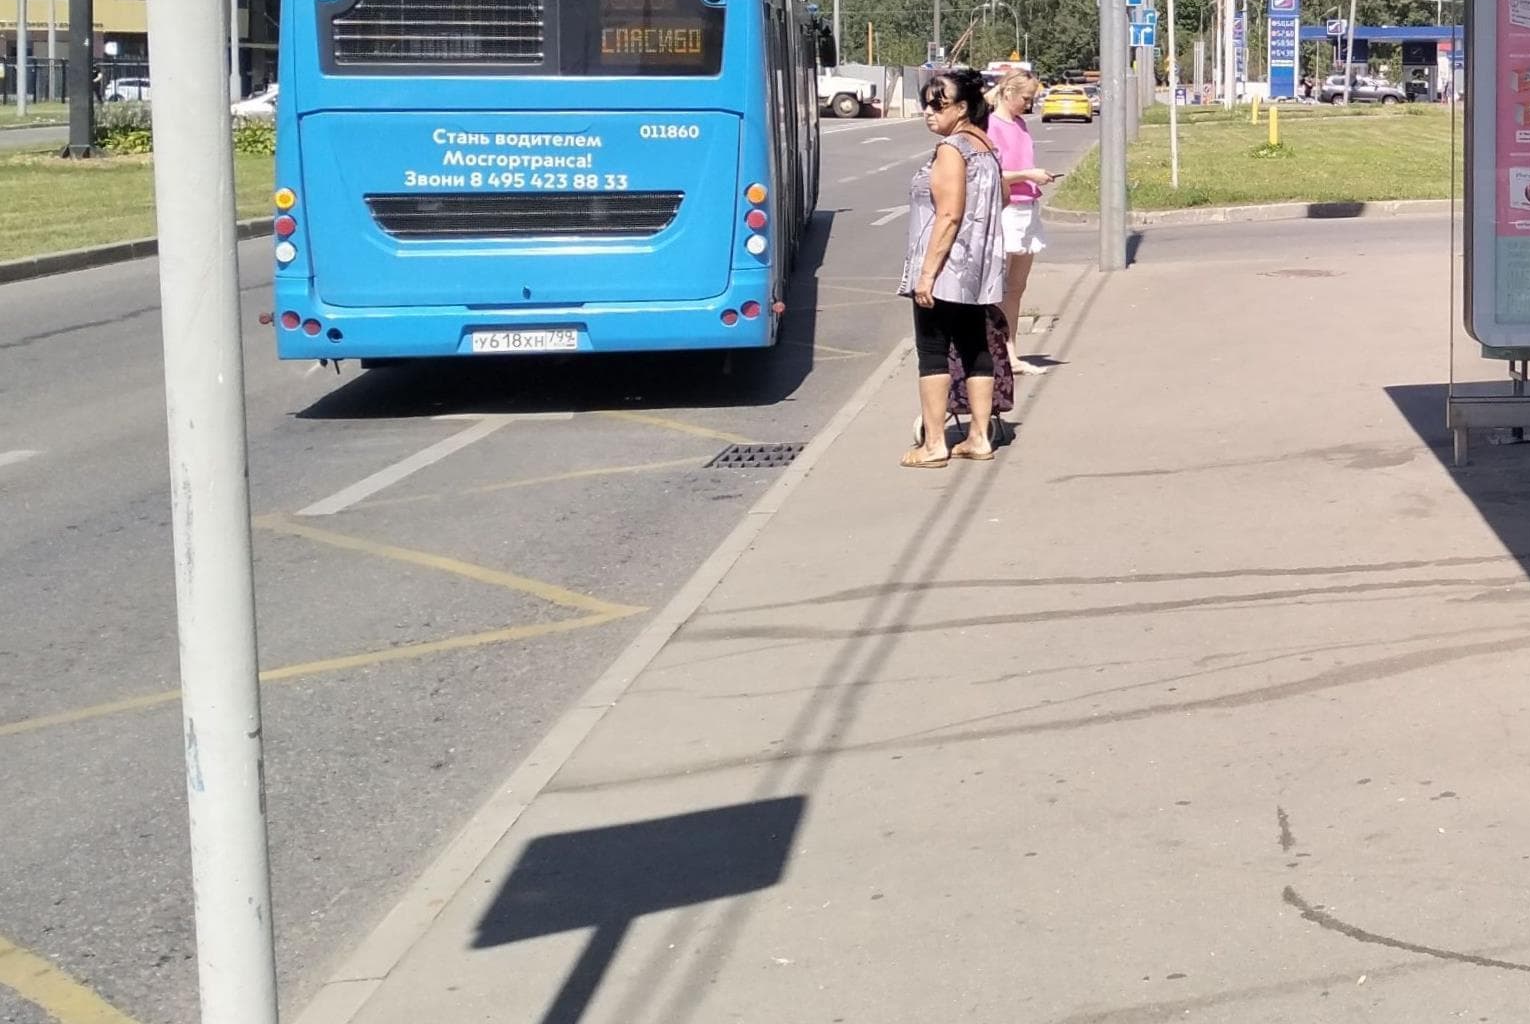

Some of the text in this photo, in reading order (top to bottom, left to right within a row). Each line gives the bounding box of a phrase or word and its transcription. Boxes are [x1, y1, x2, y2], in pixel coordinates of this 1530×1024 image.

[601, 28, 702, 54] СПАСИБО
[432, 128, 602, 149] Стань водителем
[639, 125, 699, 139] 011860
[442, 150, 593, 170] Мосгортранса!
[404, 171, 628, 190] Звони 8 495 423 88 33
